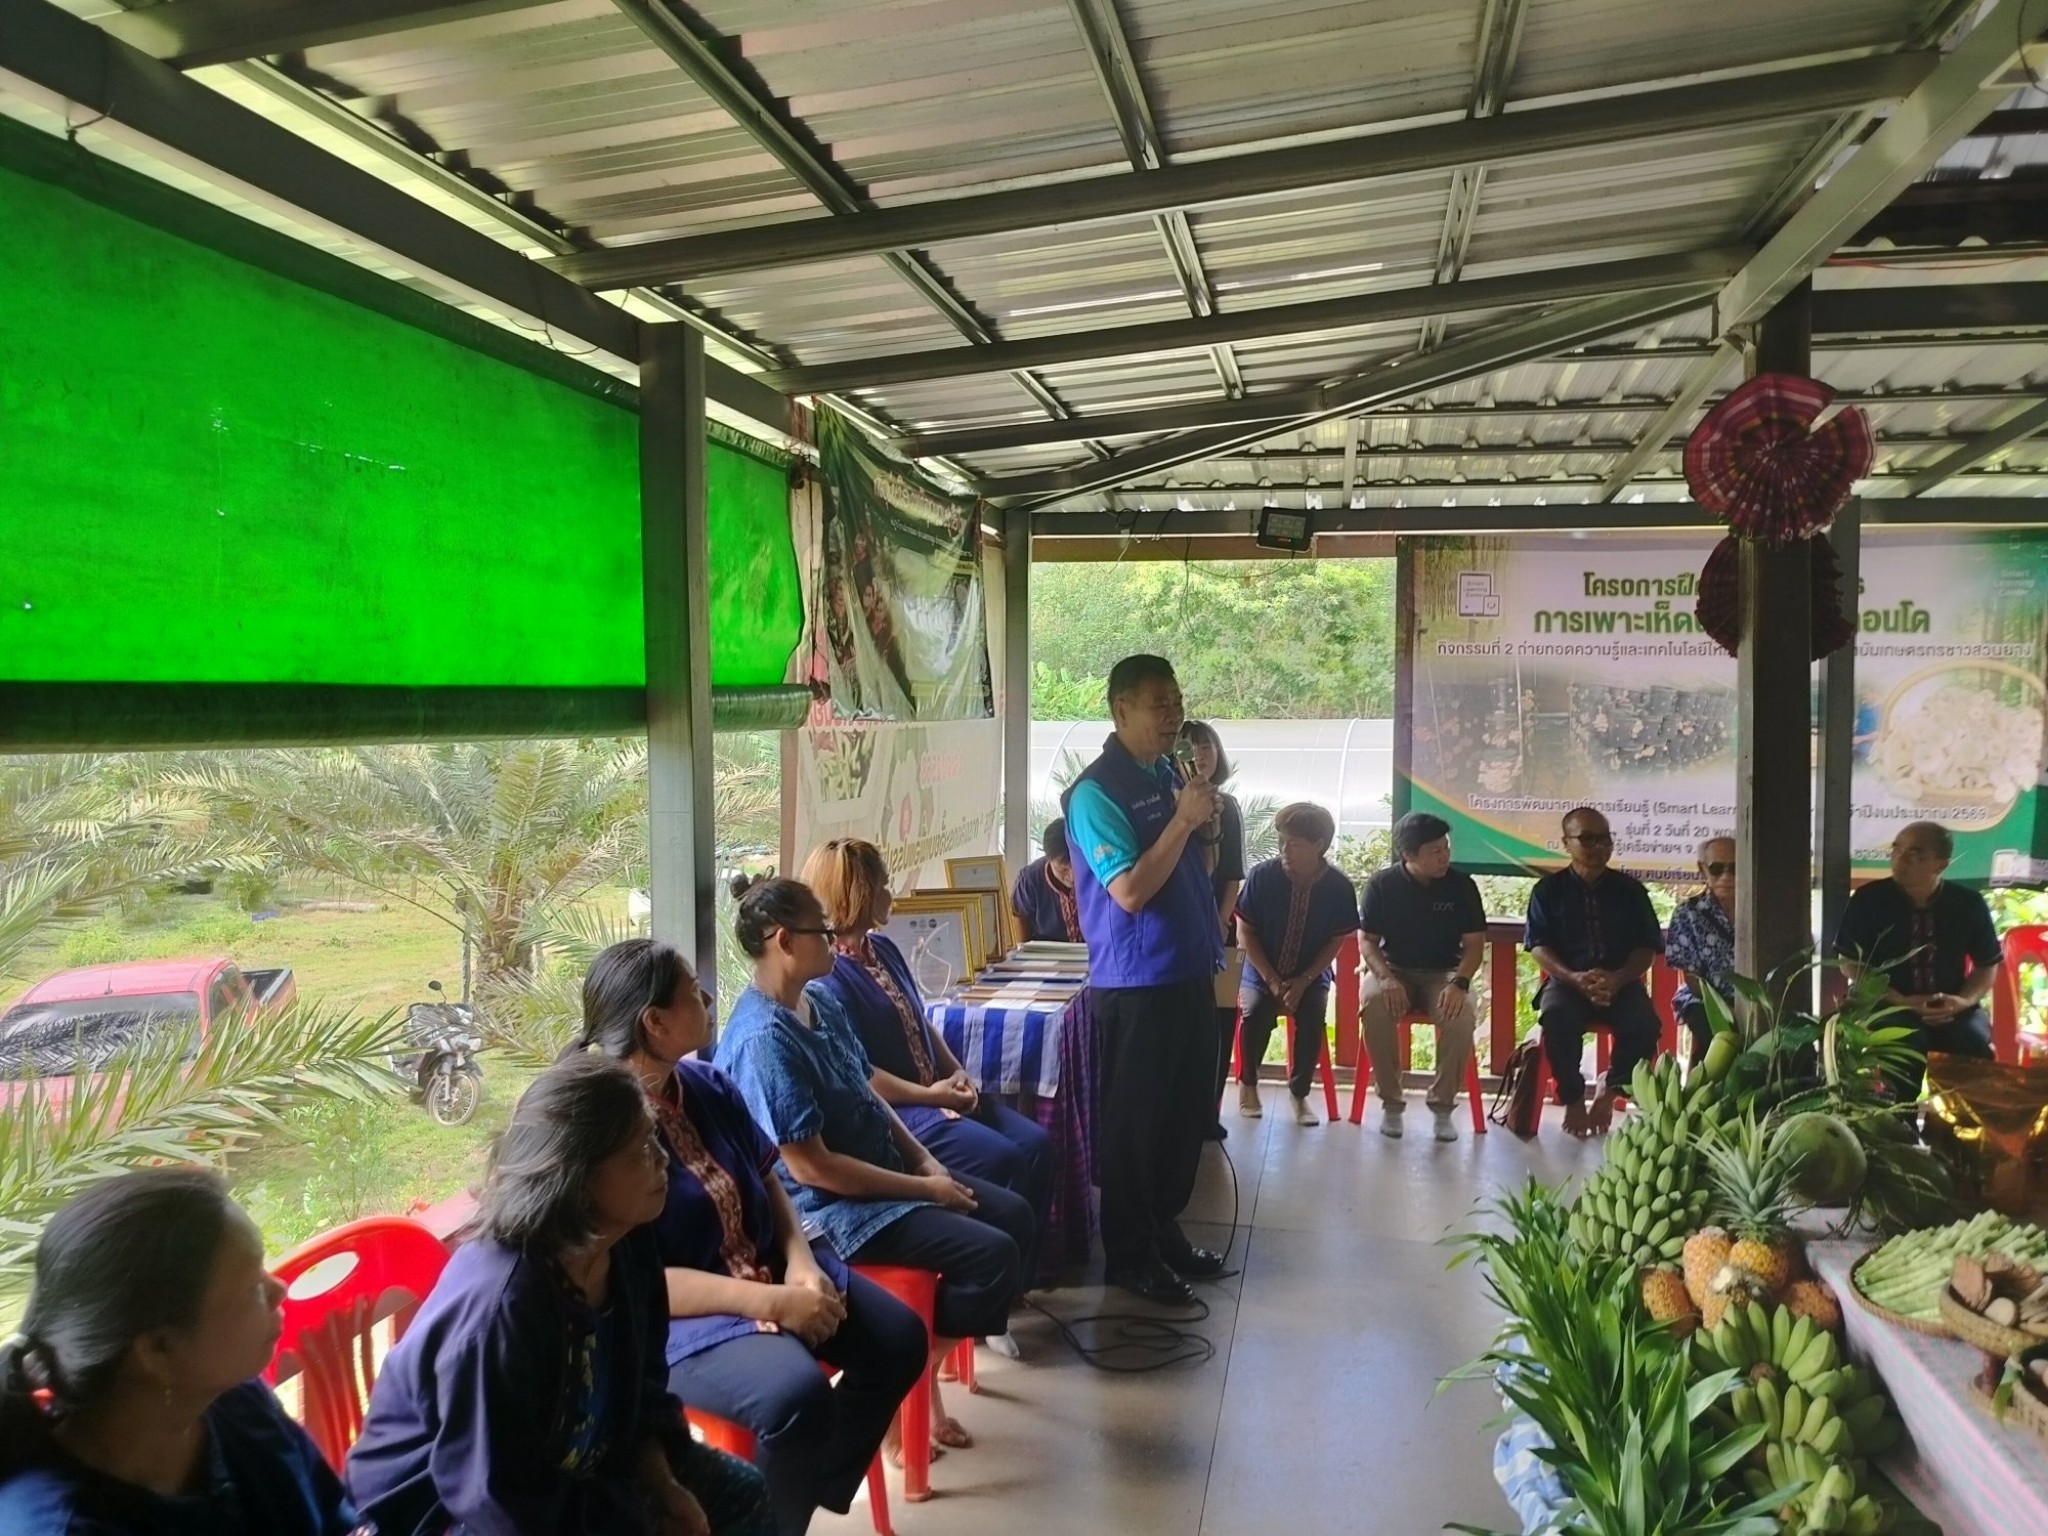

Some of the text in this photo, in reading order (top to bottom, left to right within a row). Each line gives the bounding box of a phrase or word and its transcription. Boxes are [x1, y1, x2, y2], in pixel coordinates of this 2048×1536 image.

[1856, 601, 1930, 633] อนโด
[1504, 643, 1514, 655] 2
[1653, 825, 1662, 836] 2
[1694, 826, 1710, 838] 20
